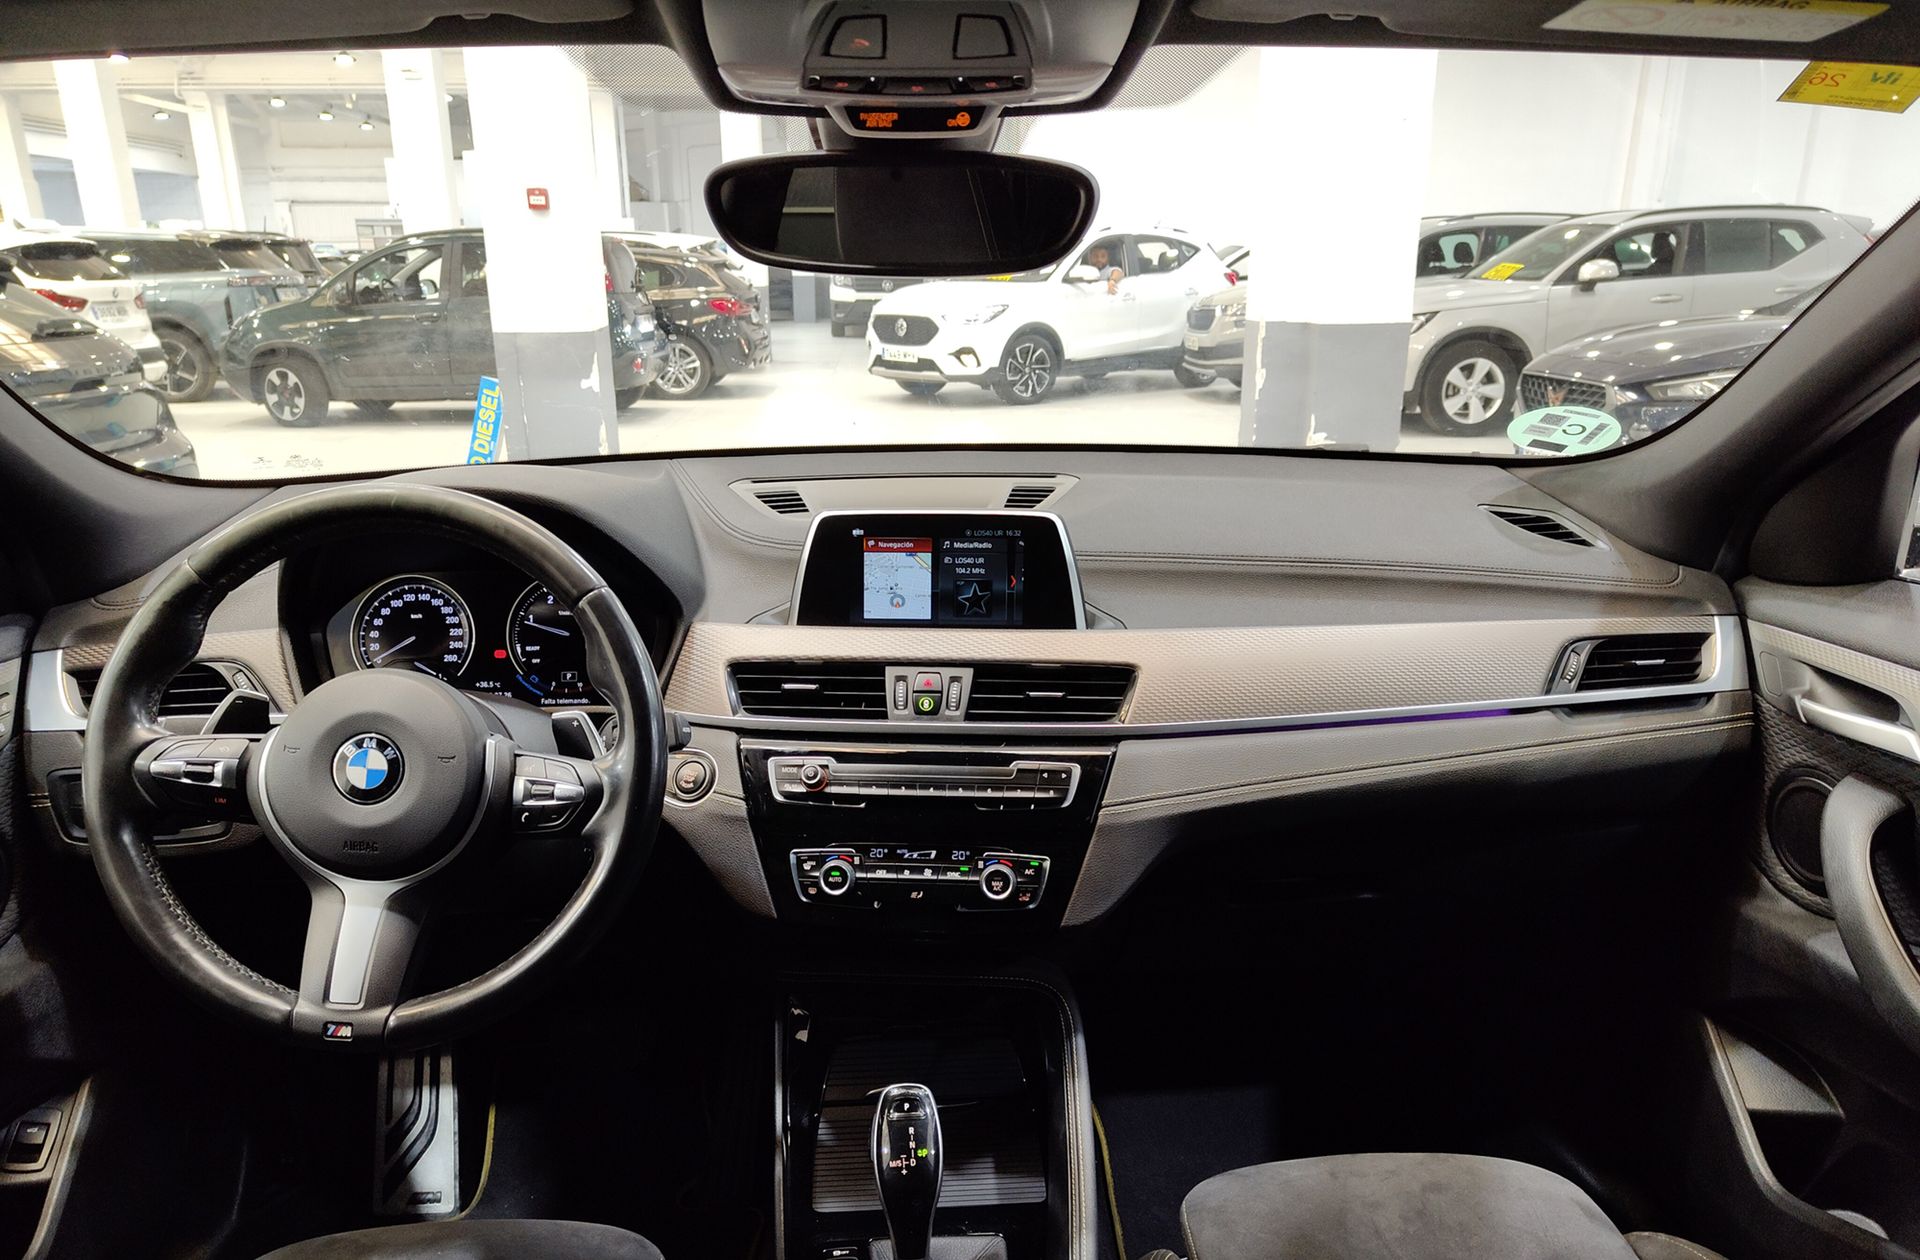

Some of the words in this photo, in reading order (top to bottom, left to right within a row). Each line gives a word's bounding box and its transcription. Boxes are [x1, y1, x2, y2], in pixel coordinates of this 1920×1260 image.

[860, 112, 898, 120] PASSENGER
[473, 385, 500, 454] DIESEL
[878, 540, 914, 549] Navegación
[953, 541, 993, 549] Media/Radio
[403, 593, 415, 601] 120
[418, 593, 430, 601] 140
[547, 595, 554, 604] 2
[441, 606, 453, 614] 180
[373, 618, 383, 626] 60
[446, 616, 459, 624] 200
[369, 630, 379, 638] 40
[449, 628, 463, 636] 220
[369, 643, 380, 651] 20
[449, 641, 463, 649] 240
[443, 654, 458, 662] 260
[343, 738, 397, 760] BMW
[342, 840, 380, 853] AIRBAG
[904, 1103, 910, 1111] P
[908, 1126, 915, 1135] R
[909, 1141, 916, 1149] N
[889, 1160, 902, 1168] M/S
[910, 1158, 916, 1167] D
